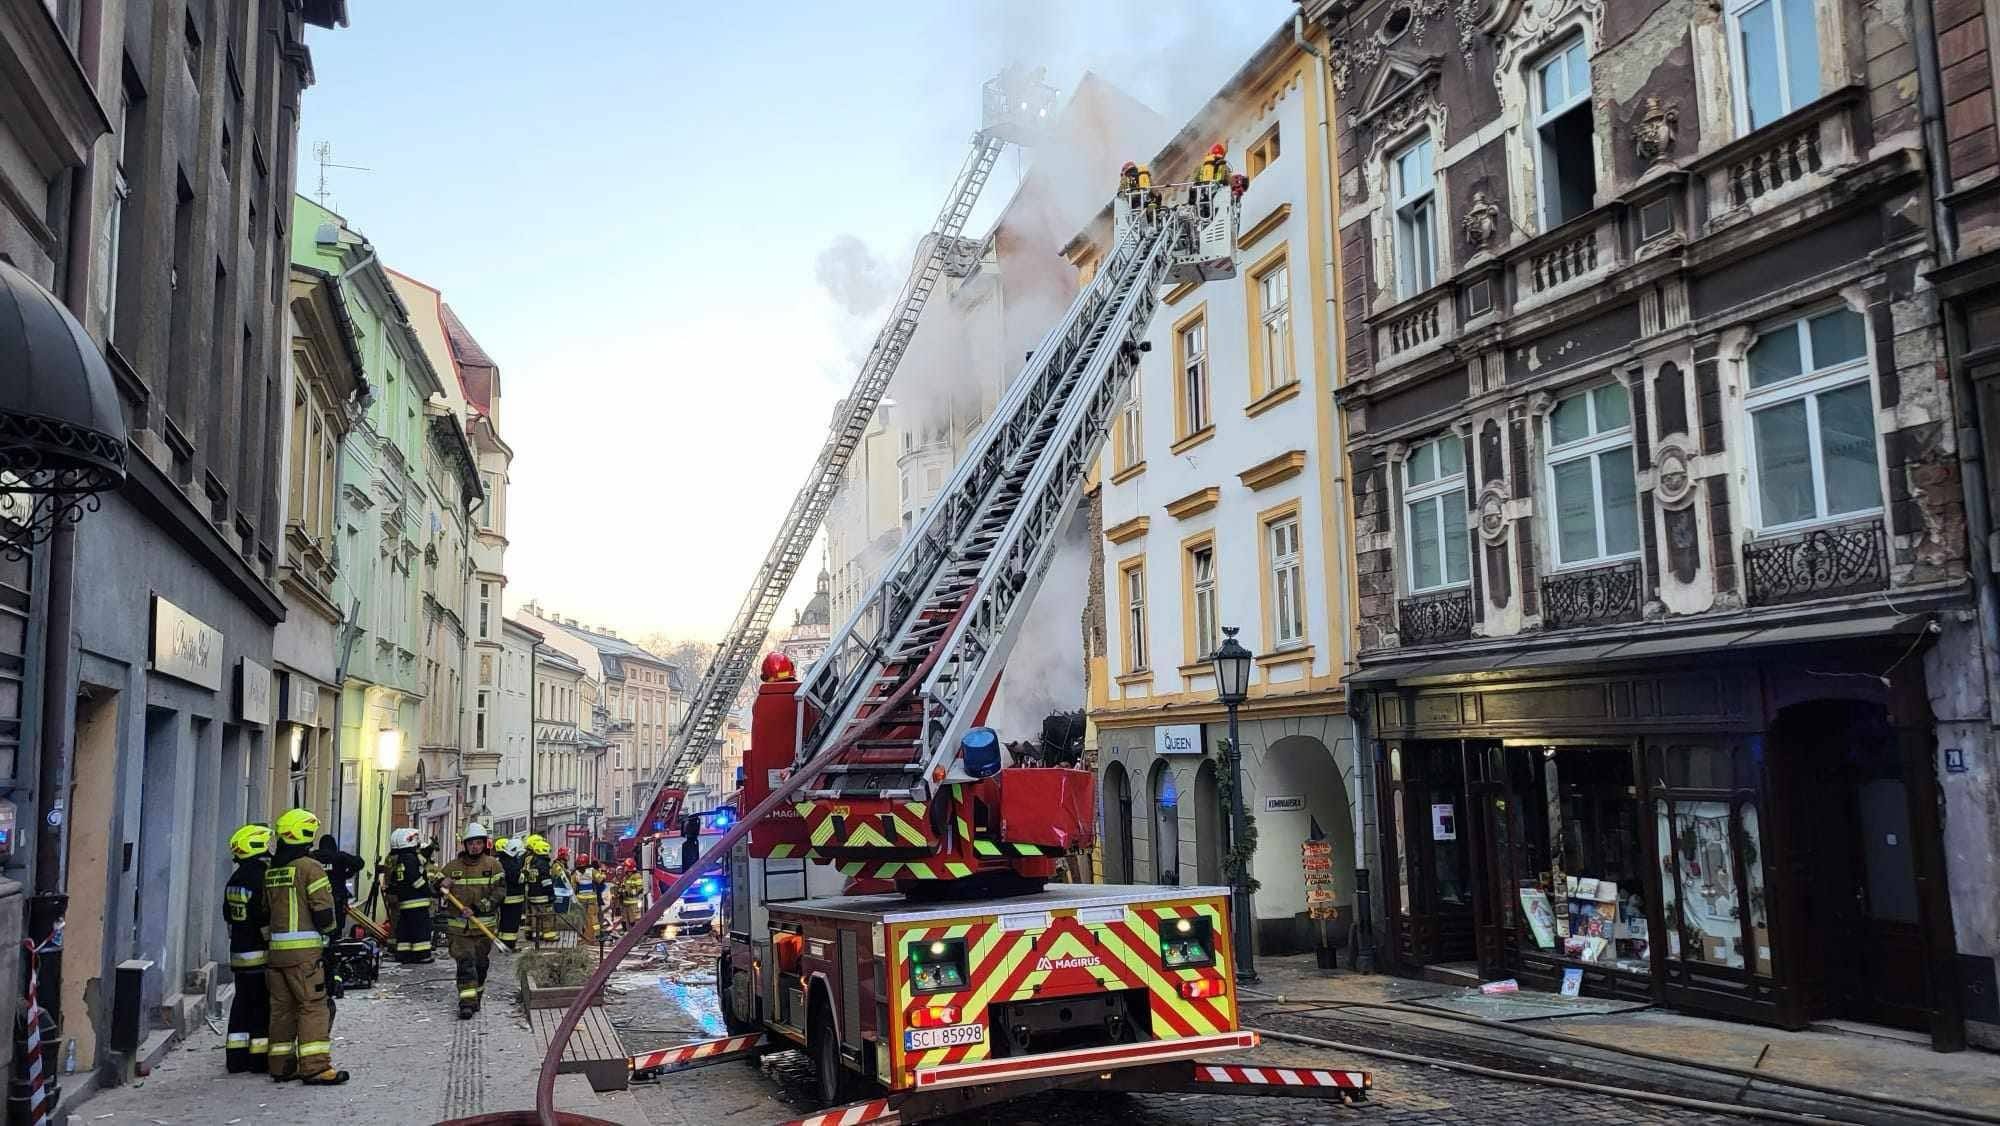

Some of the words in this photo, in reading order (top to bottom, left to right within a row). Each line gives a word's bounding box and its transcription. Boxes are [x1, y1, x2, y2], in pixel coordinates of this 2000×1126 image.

[1164, 735, 1192, 750] QUEEN
[1055, 957, 1100, 969] MAGIRUS
[912, 1031, 936, 1048] SCI
[942, 1026, 982, 1044] 85998
